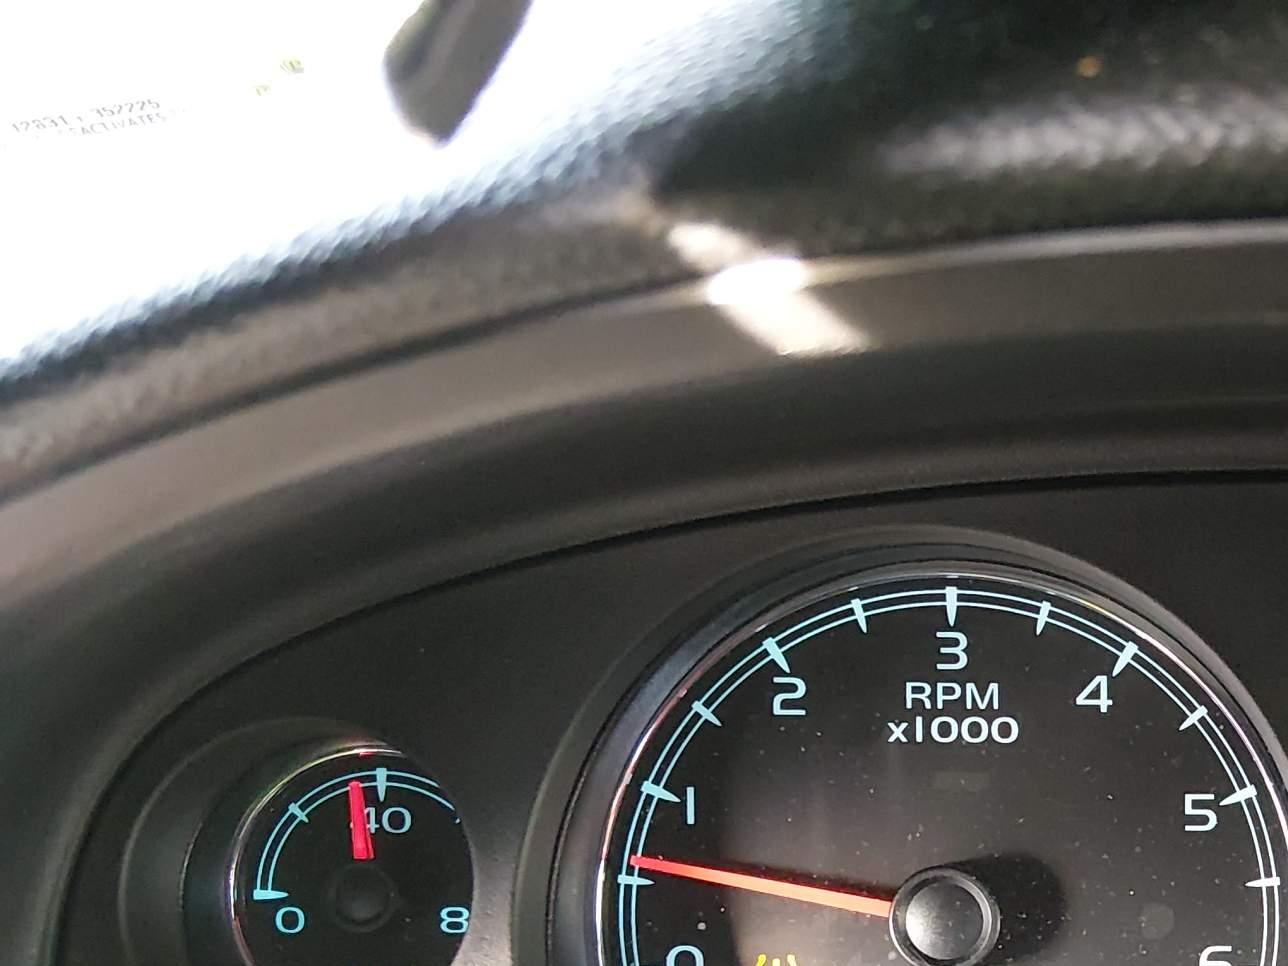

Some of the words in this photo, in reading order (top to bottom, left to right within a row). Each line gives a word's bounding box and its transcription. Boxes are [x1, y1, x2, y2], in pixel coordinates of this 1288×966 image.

[936, 632, 967, 669] 3
[773, 677, 806, 715] 2
[906, 682, 998, 709] RPM
[1076, 676, 1112, 712] 4
[888, 716, 1018, 743] x1000
[687, 787, 694, 824] 1
[1185, 794, 1217, 831] 5
[275, 906, 305, 933] 0
